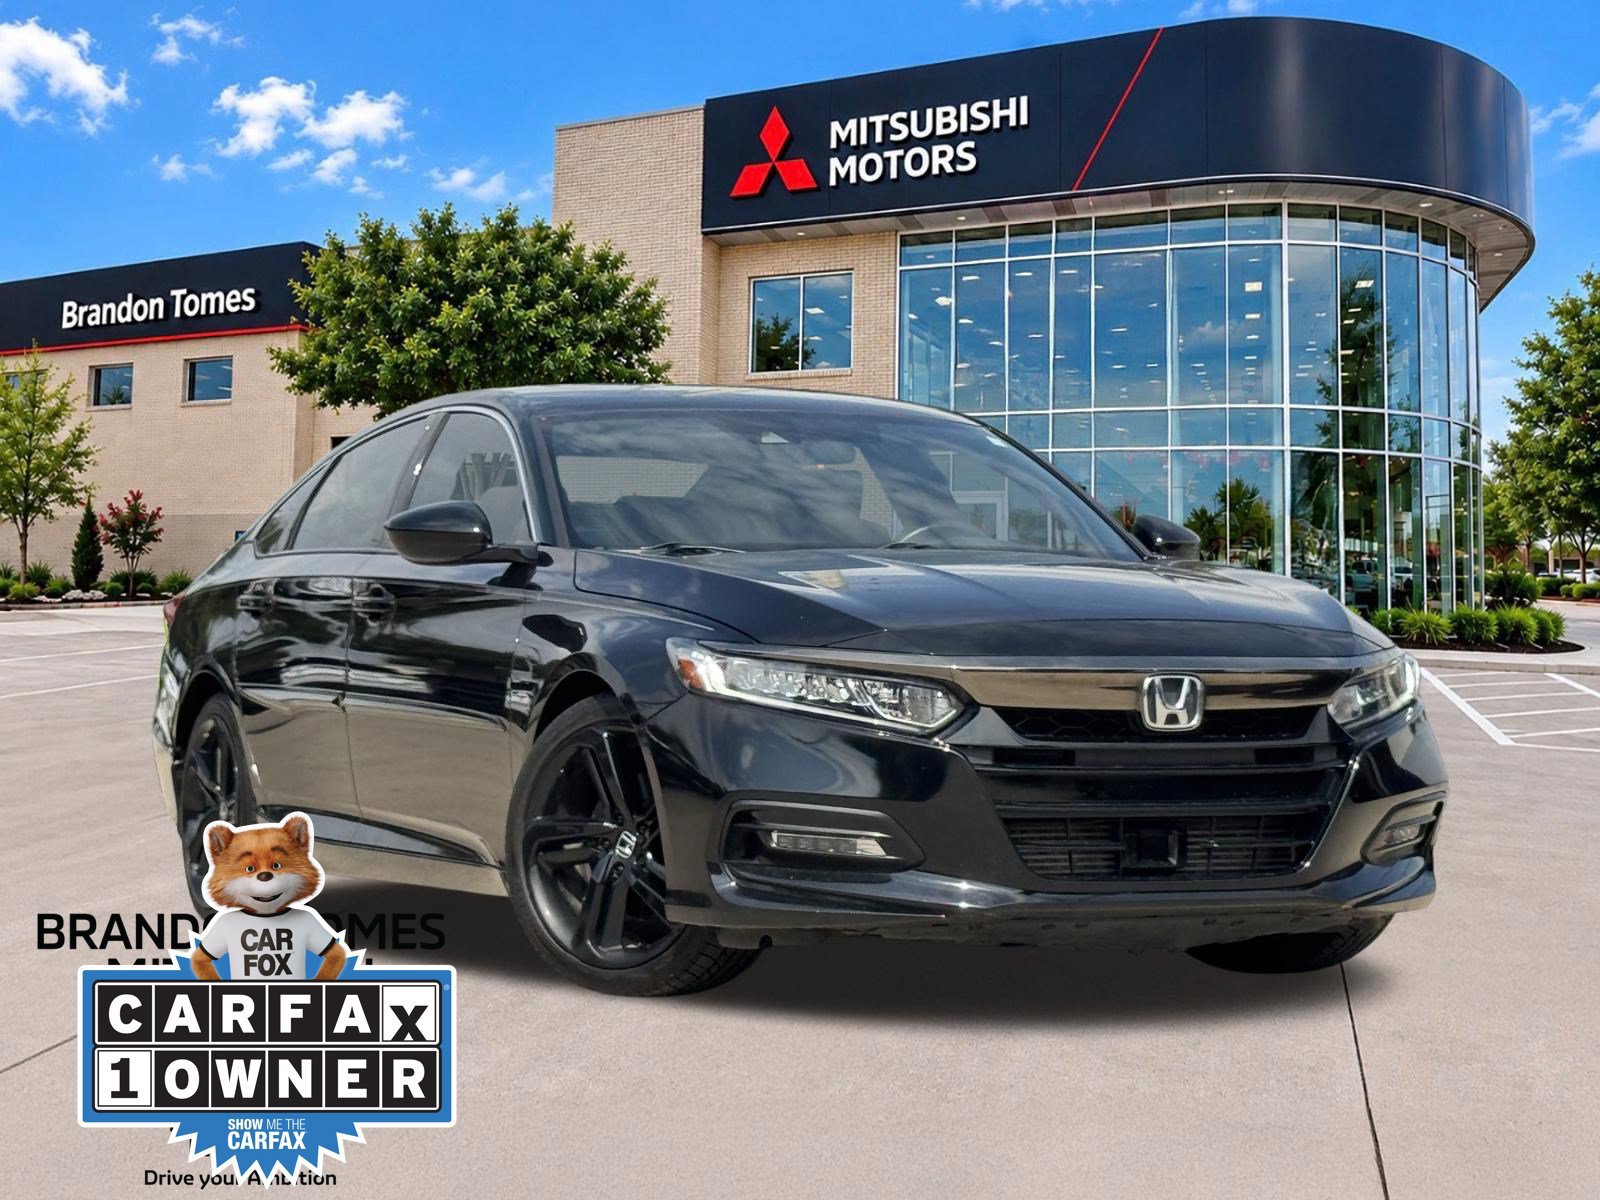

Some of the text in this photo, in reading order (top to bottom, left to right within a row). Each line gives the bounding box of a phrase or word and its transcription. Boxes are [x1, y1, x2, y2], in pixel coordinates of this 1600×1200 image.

[829, 95, 1029, 149] MITSUBISHI
[829, 140, 977, 187] MOTORS
[61, 287, 256, 329] Brandon Tomes
